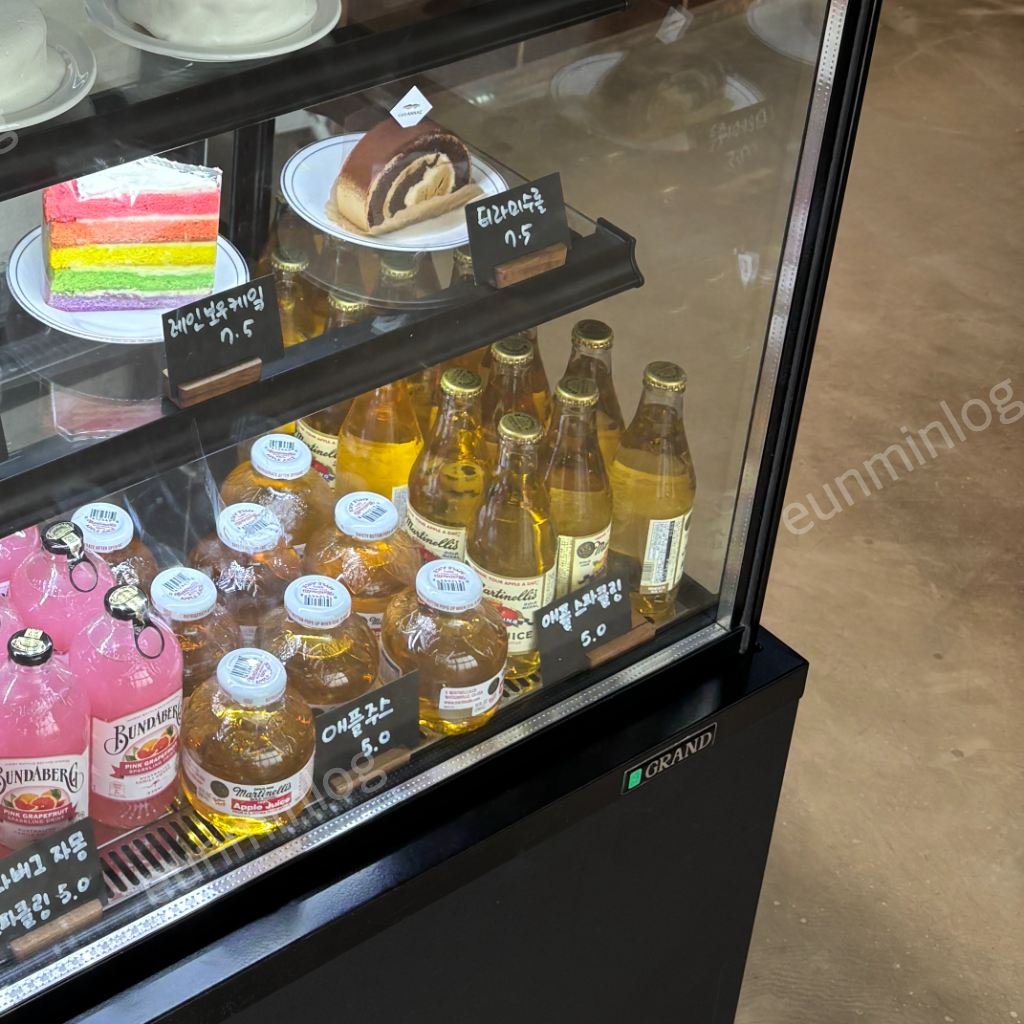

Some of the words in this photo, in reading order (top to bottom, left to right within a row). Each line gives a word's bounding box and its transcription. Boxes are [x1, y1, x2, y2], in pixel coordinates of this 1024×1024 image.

[505, 223, 532, 248] 7.5
[220, 318, 254, 345] 7.5
[541, 602, 574, 632] 애플
[574, 579, 623, 617] 스파클링
[580, 623, 607, 648] 5.0
[361, 730, 391, 757] 5.0
[645, 731, 712, 779] GRAND
[233, 802, 263, 812] Apple
[265, 796, 291, 809] Juice
[50, 829, 88, 862] 자몽
[56, 876, 91, 904] 5.0
